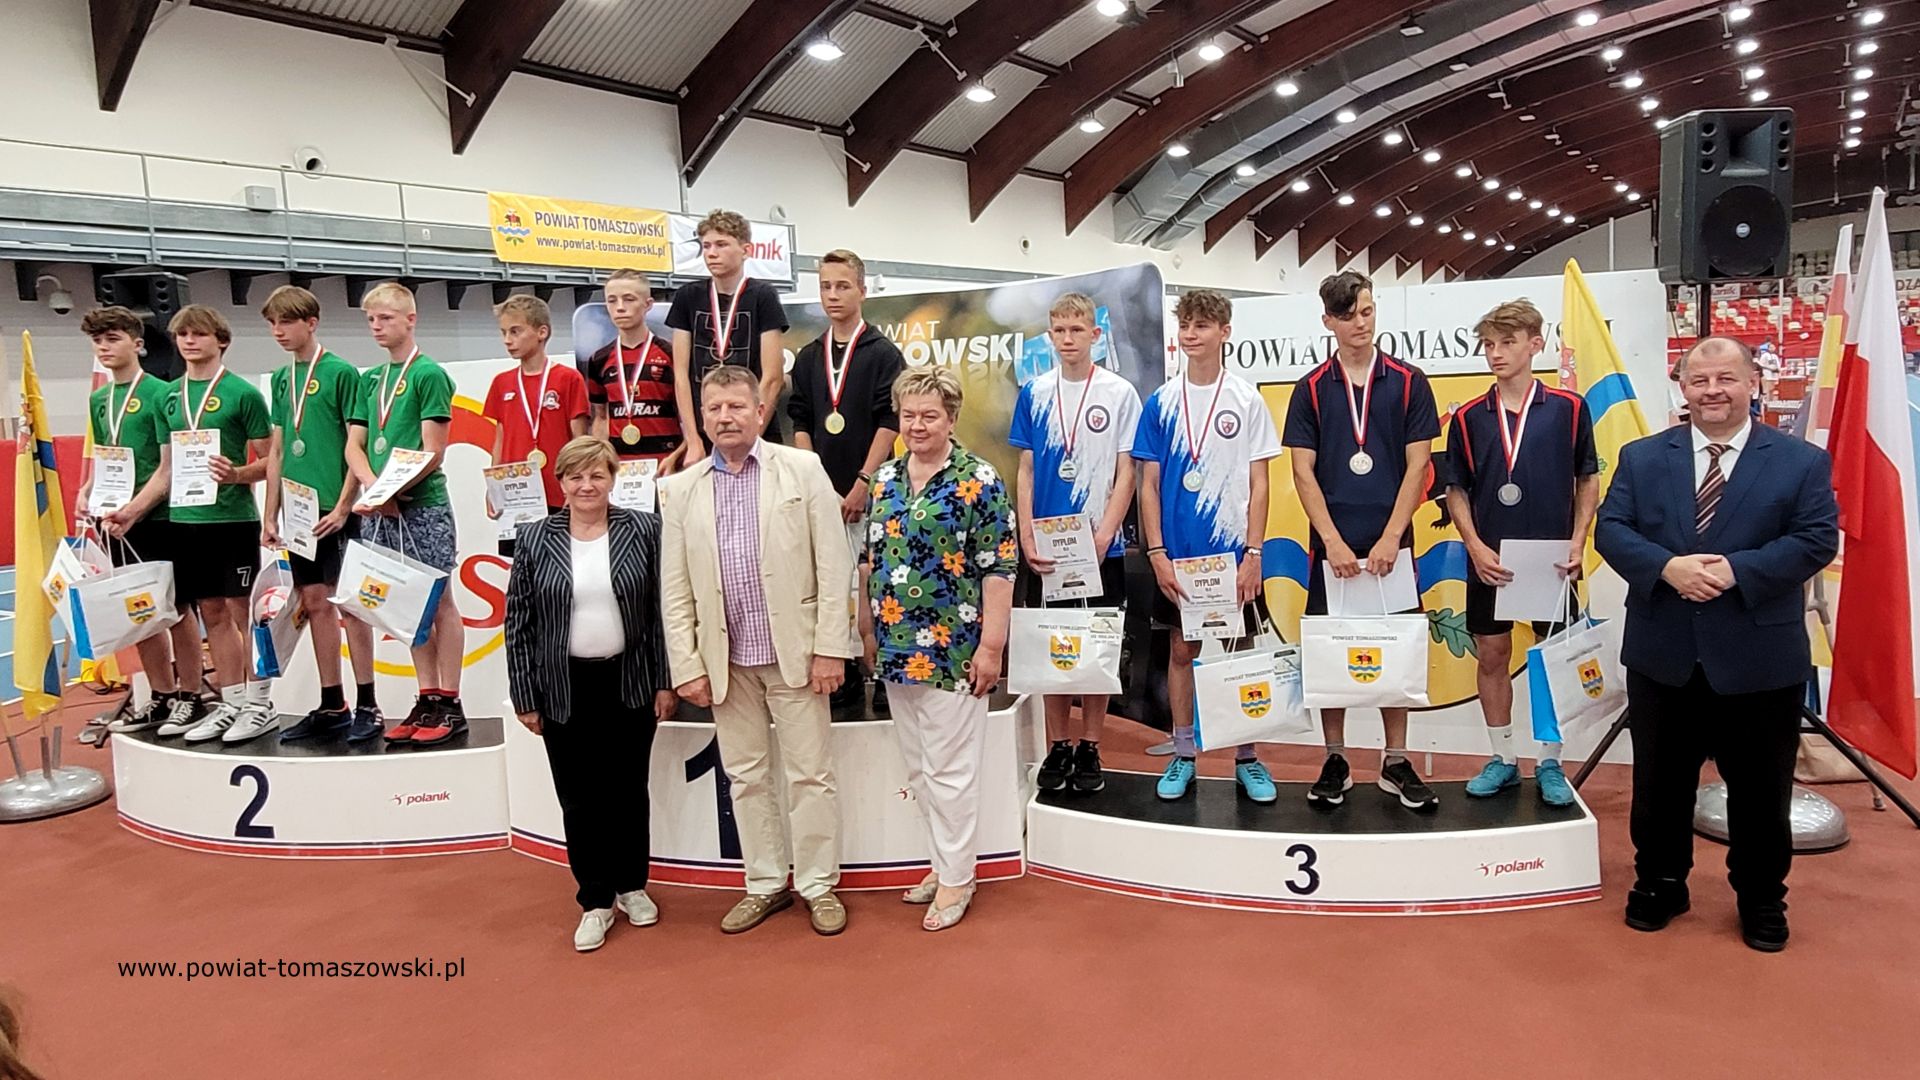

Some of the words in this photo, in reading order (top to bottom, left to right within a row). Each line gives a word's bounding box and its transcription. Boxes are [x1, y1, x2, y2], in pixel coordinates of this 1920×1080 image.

[534, 211, 582, 231] POWIAT
[583, 216, 665, 238] TOMASZOWSKI
[536, 236, 666, 258] www.powiat-tomaszowski.pl
[877, 321, 941, 342] WIAT
[1221, 334, 1337, 369] POWIAT
[1052, 537, 1078, 548] DYPLOM
[237, 565, 251, 587] 7
[1194, 578, 1221, 588] DYPLOM
[229, 764, 275, 839] 2
[405, 790, 452, 806] polanik
[1284, 844, 1321, 895] 3
[1493, 857, 1546, 877] polanik
